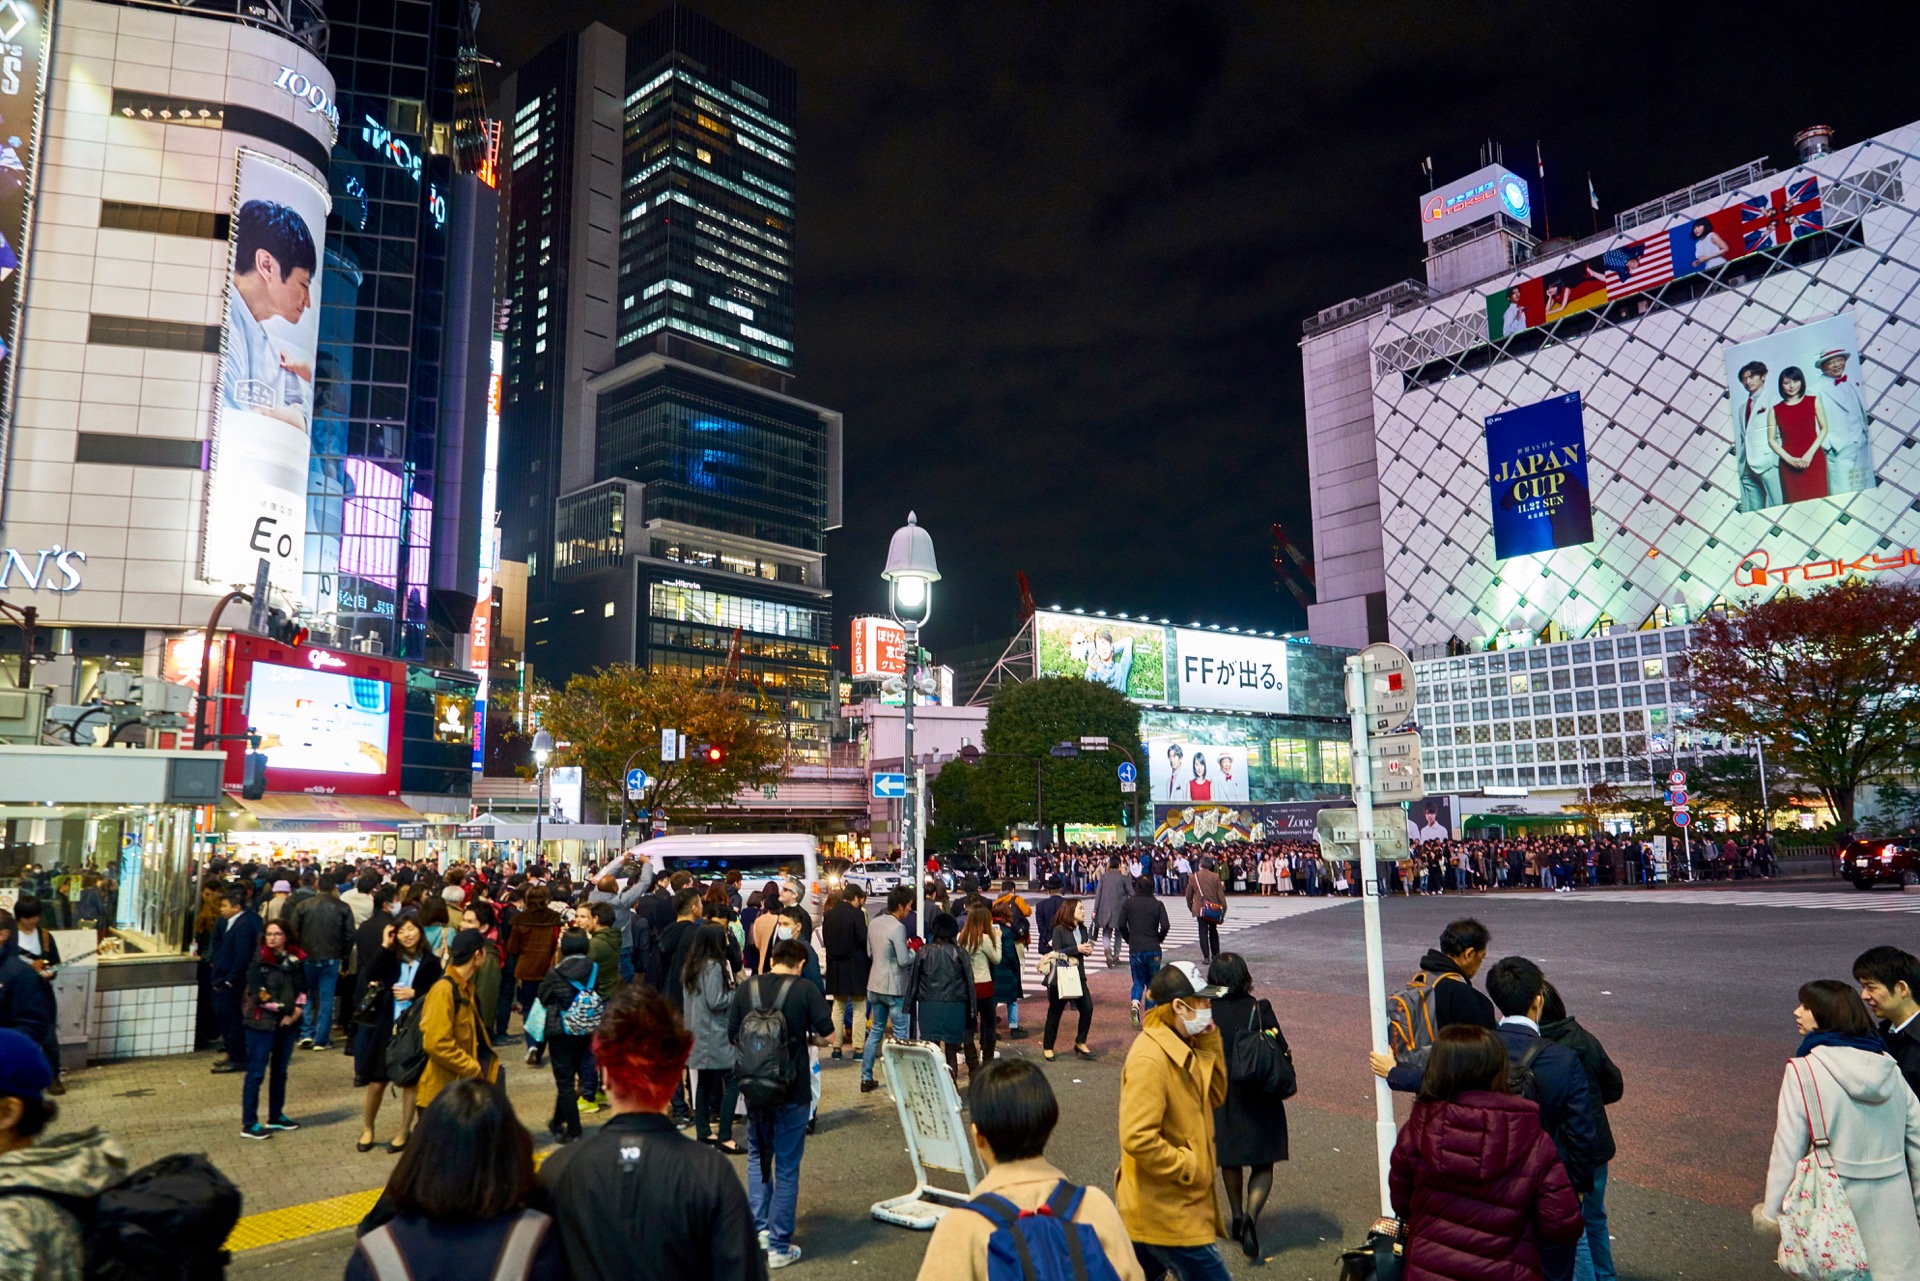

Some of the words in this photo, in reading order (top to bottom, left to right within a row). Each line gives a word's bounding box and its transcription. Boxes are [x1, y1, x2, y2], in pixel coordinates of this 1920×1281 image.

[1443, 188, 1497, 215] TOKYU
[1494, 443, 1580, 483] JAPAN
[1513, 472, 1566, 502] CUP
[1517, 500, 1540, 514] 11.27
[1542, 495, 1565, 508] SUN
[1185, 655, 1283, 691] FFが出る。
[763, 785, 778, 800] 駅
[1287, 815, 1313, 828] Zone
